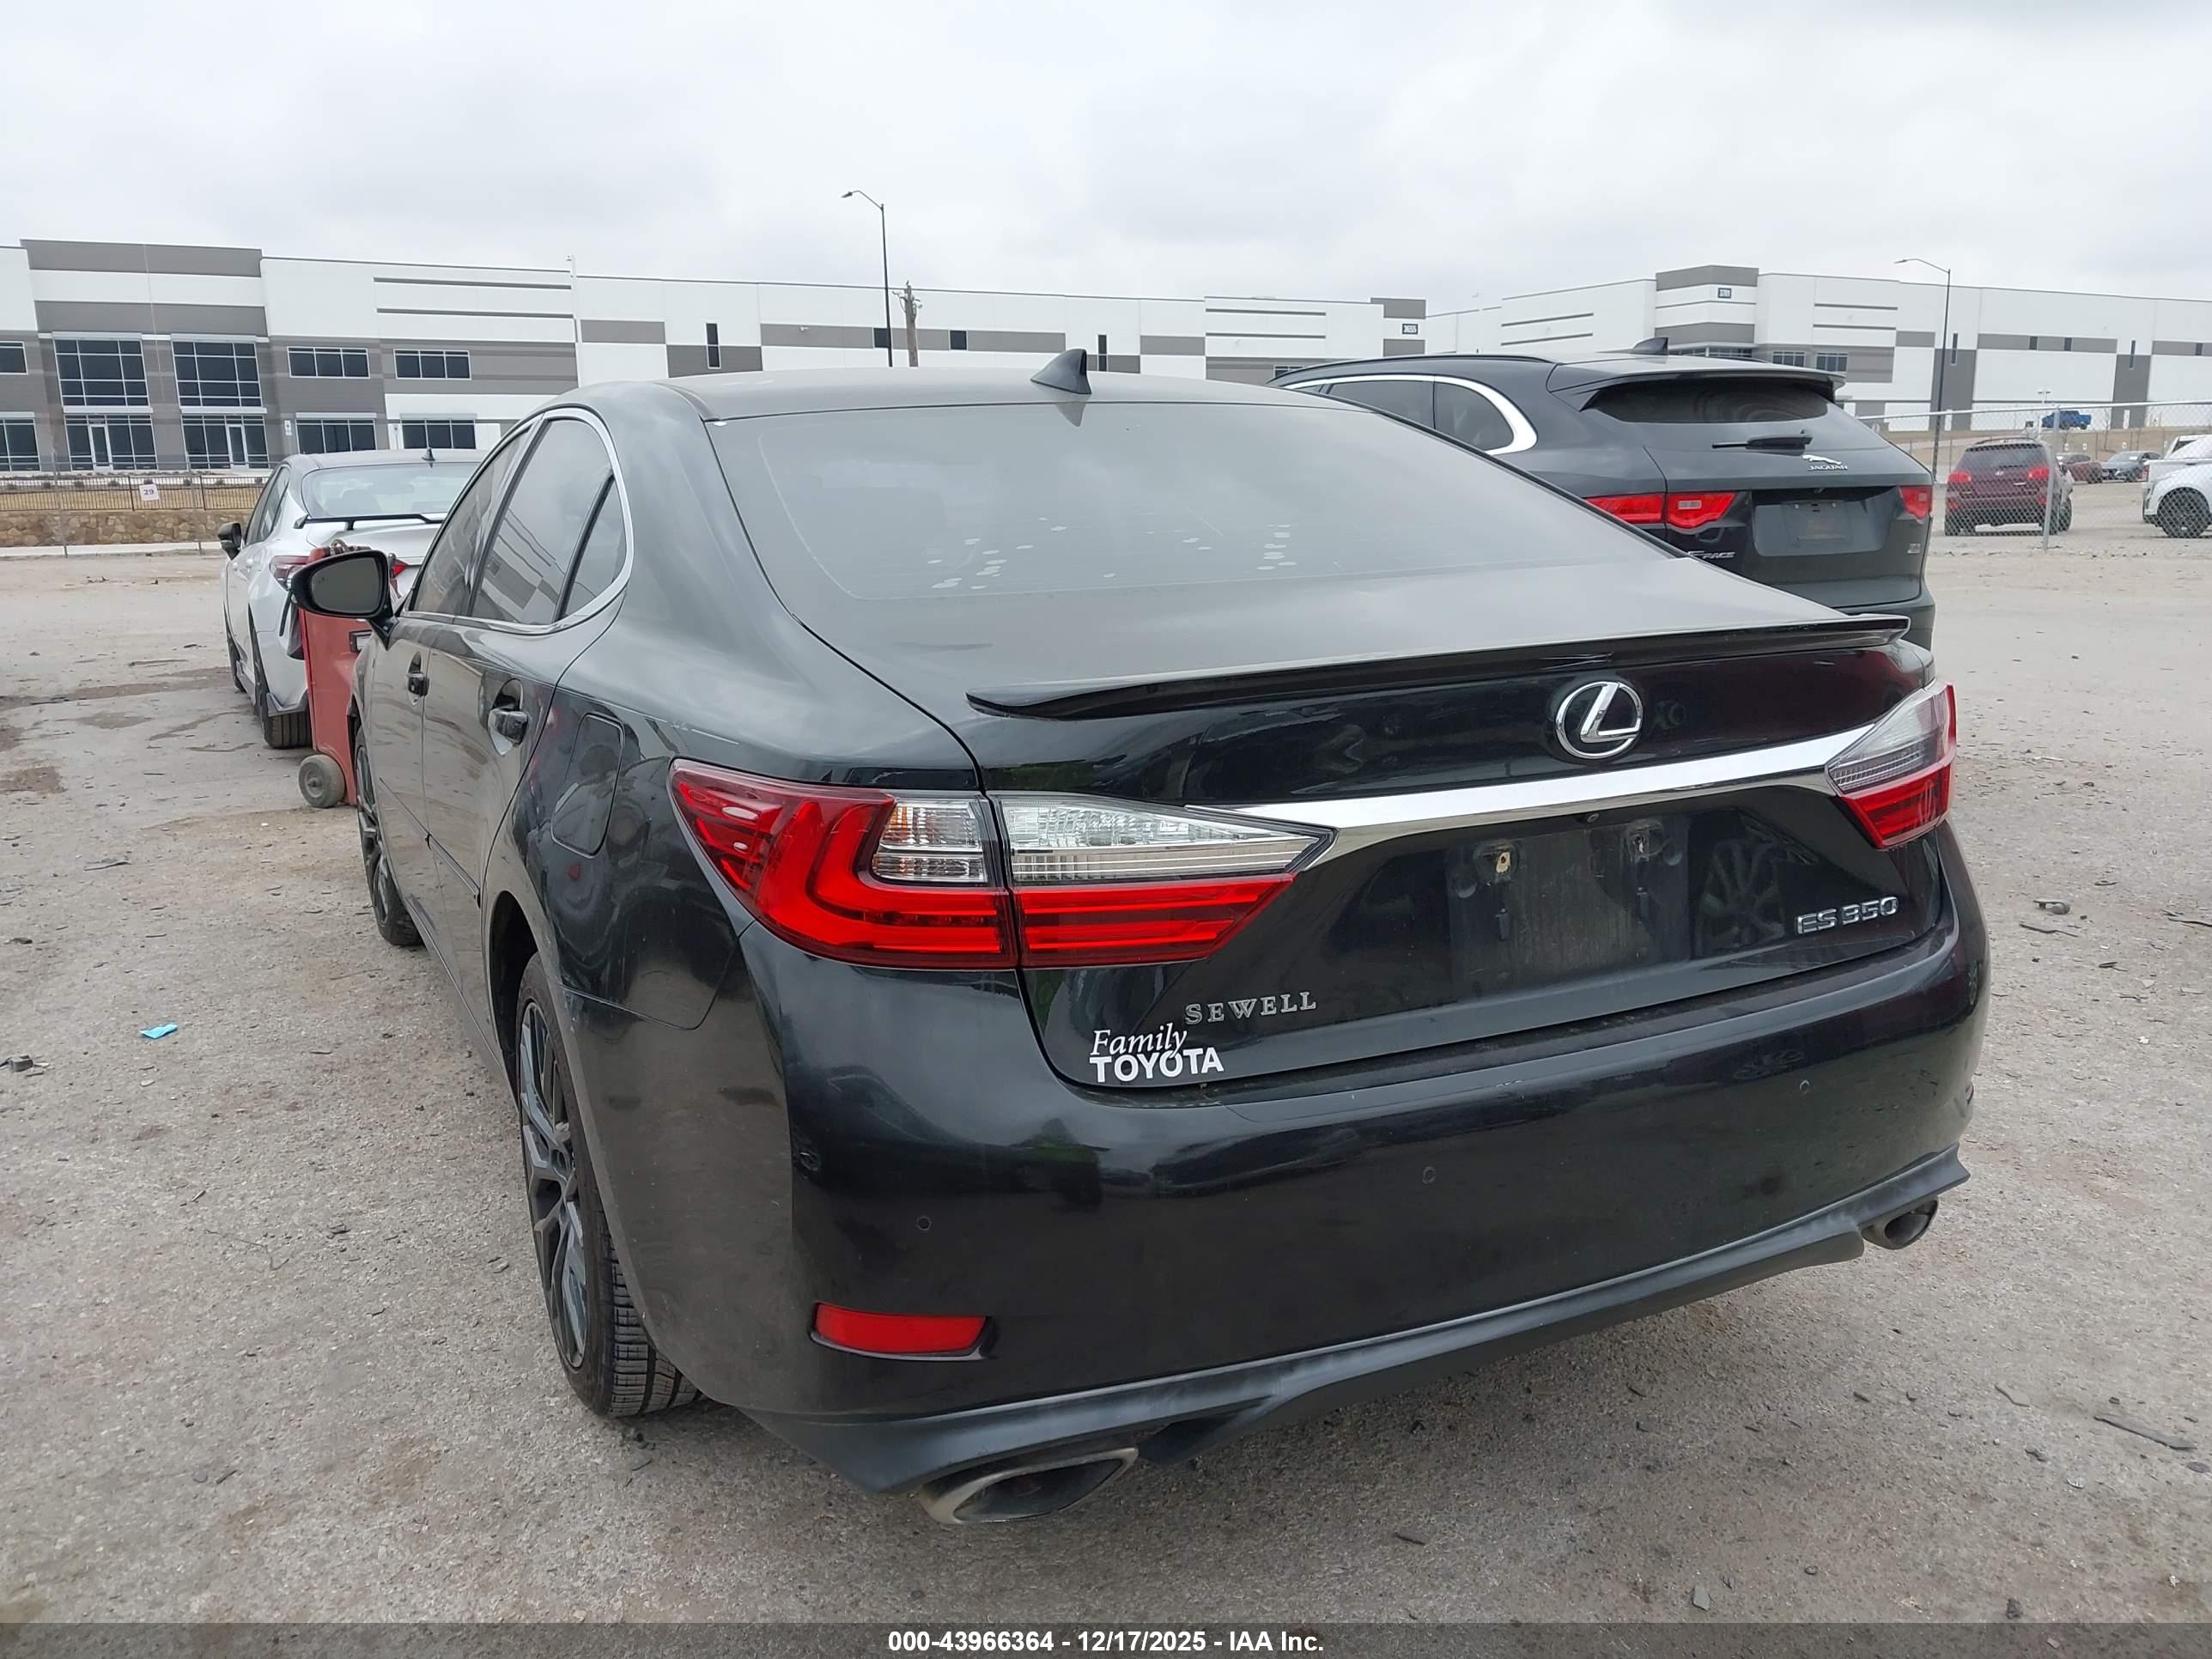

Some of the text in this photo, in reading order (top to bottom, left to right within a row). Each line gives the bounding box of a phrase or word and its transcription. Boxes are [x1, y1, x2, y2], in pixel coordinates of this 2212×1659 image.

[1796, 896, 1899, 934] ES 350
[1184, 991, 1317, 1025] SEWELL
[1090, 1022, 1188, 1059] Family
[1089, 1047, 1224, 1083] TOYOTA
